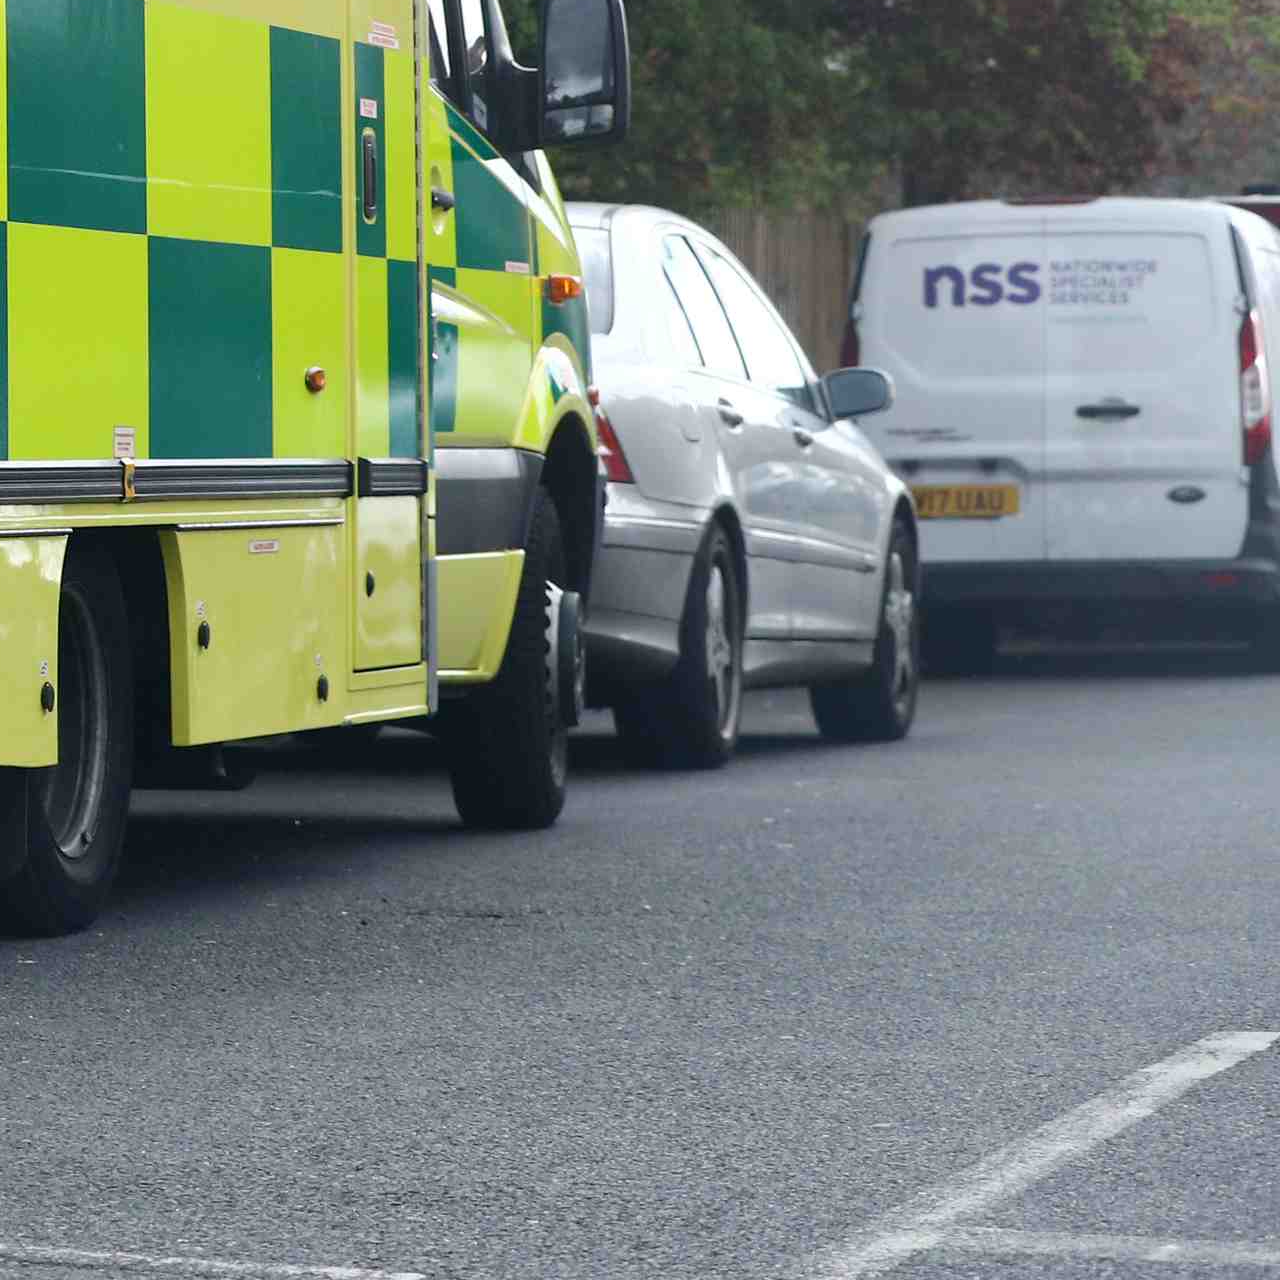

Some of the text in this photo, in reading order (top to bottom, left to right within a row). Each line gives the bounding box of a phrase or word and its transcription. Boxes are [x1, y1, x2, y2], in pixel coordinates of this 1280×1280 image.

[1050, 260, 1158, 273] NATIONWIDE
[923, 262, 1041, 308] nss
[1049, 275, 1145, 289] SPECIALIST
[1049, 291, 1129, 305] SERVICES
